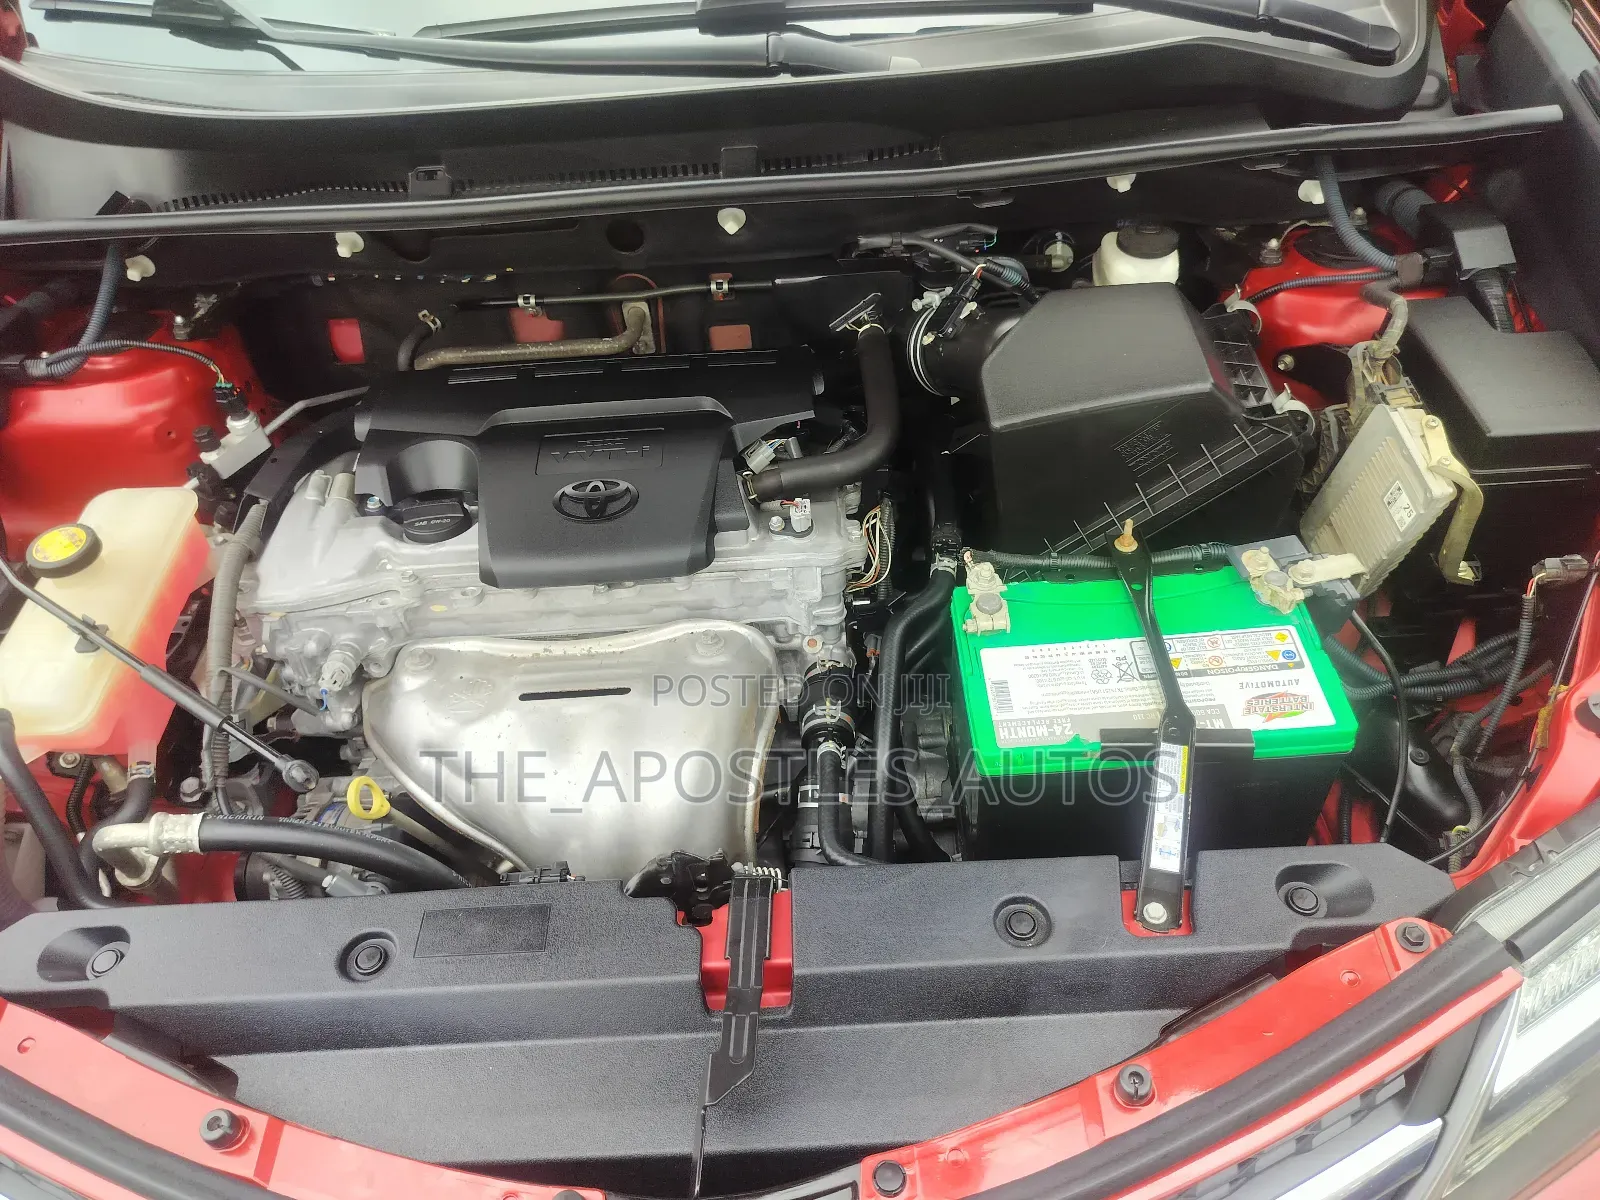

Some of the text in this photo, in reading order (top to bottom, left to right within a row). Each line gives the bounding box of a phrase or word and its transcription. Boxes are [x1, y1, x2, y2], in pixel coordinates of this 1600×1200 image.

[1206, 663, 1279, 675] DANGER/POISON
[1238, 678, 1300, 690] AUTOMOTIVE
[1245, 694, 1309, 707] BATTERIES
[1205, 707, 1220, 715] CCA
[1244, 702, 1314, 715] INTERSTATE
[998, 718, 1050, 728] REPLACEMENT
[1195, 718, 1226, 729] MT-
[998, 722, 1073, 739] 24-MONTH
